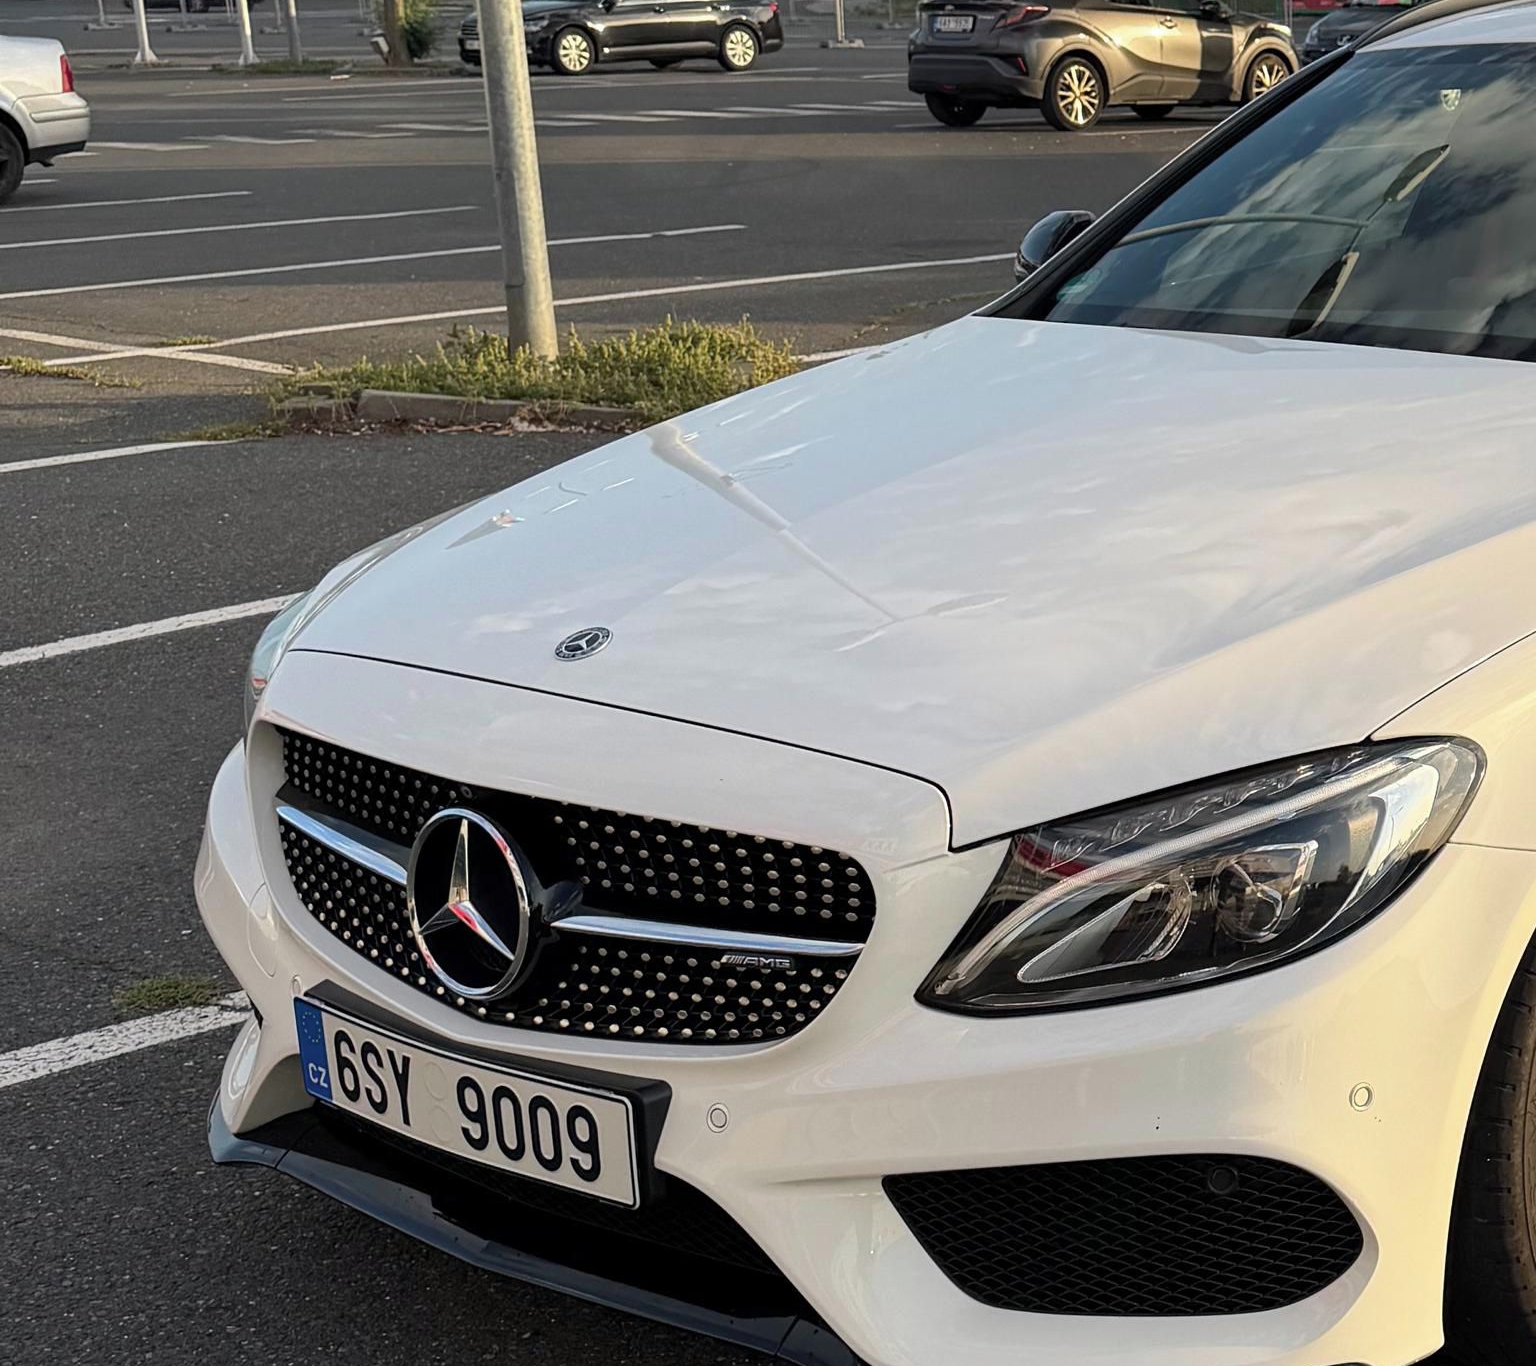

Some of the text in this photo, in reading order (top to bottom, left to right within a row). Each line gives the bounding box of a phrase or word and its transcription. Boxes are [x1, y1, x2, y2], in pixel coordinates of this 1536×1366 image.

[308, 1063, 329, 1089] CZ
[334, 1029, 601, 1182] 6SY 9009
